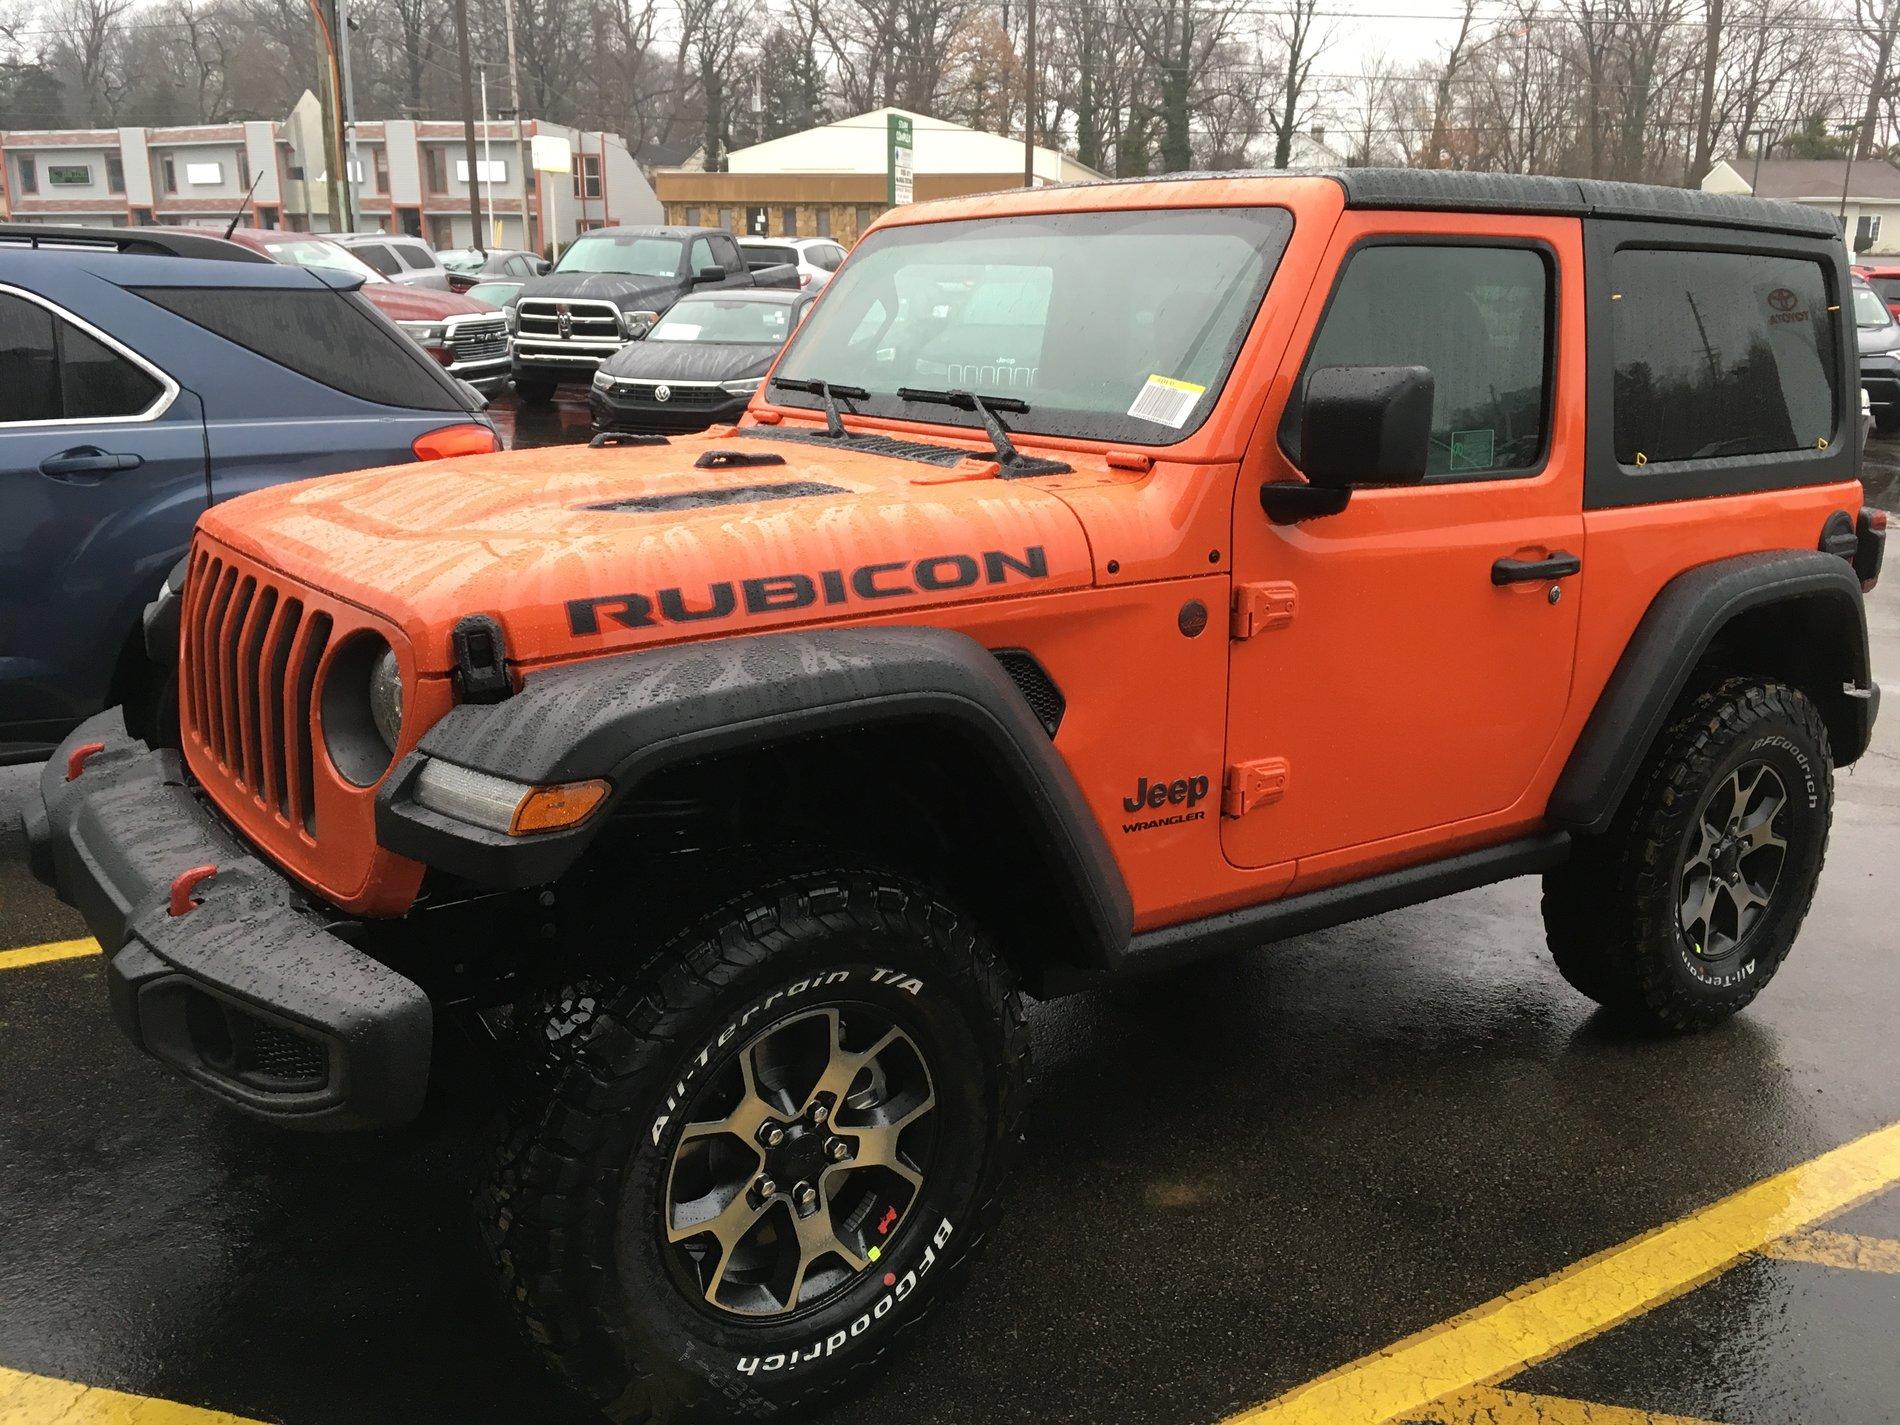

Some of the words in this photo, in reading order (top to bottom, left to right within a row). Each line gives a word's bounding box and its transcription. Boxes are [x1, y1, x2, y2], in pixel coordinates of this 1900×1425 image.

[563, 545, 1050, 638] RUBICON
[1123, 775, 1209, 813] Jeep
[1749, 735, 1817, 809] BFGoodrich
[1121, 811, 1205, 834] WRANGLER
[652, 970, 849, 1146] All-Terrain
[870, 968, 924, 996] T/A
[736, 1217, 954, 1376] BFGoodrich
